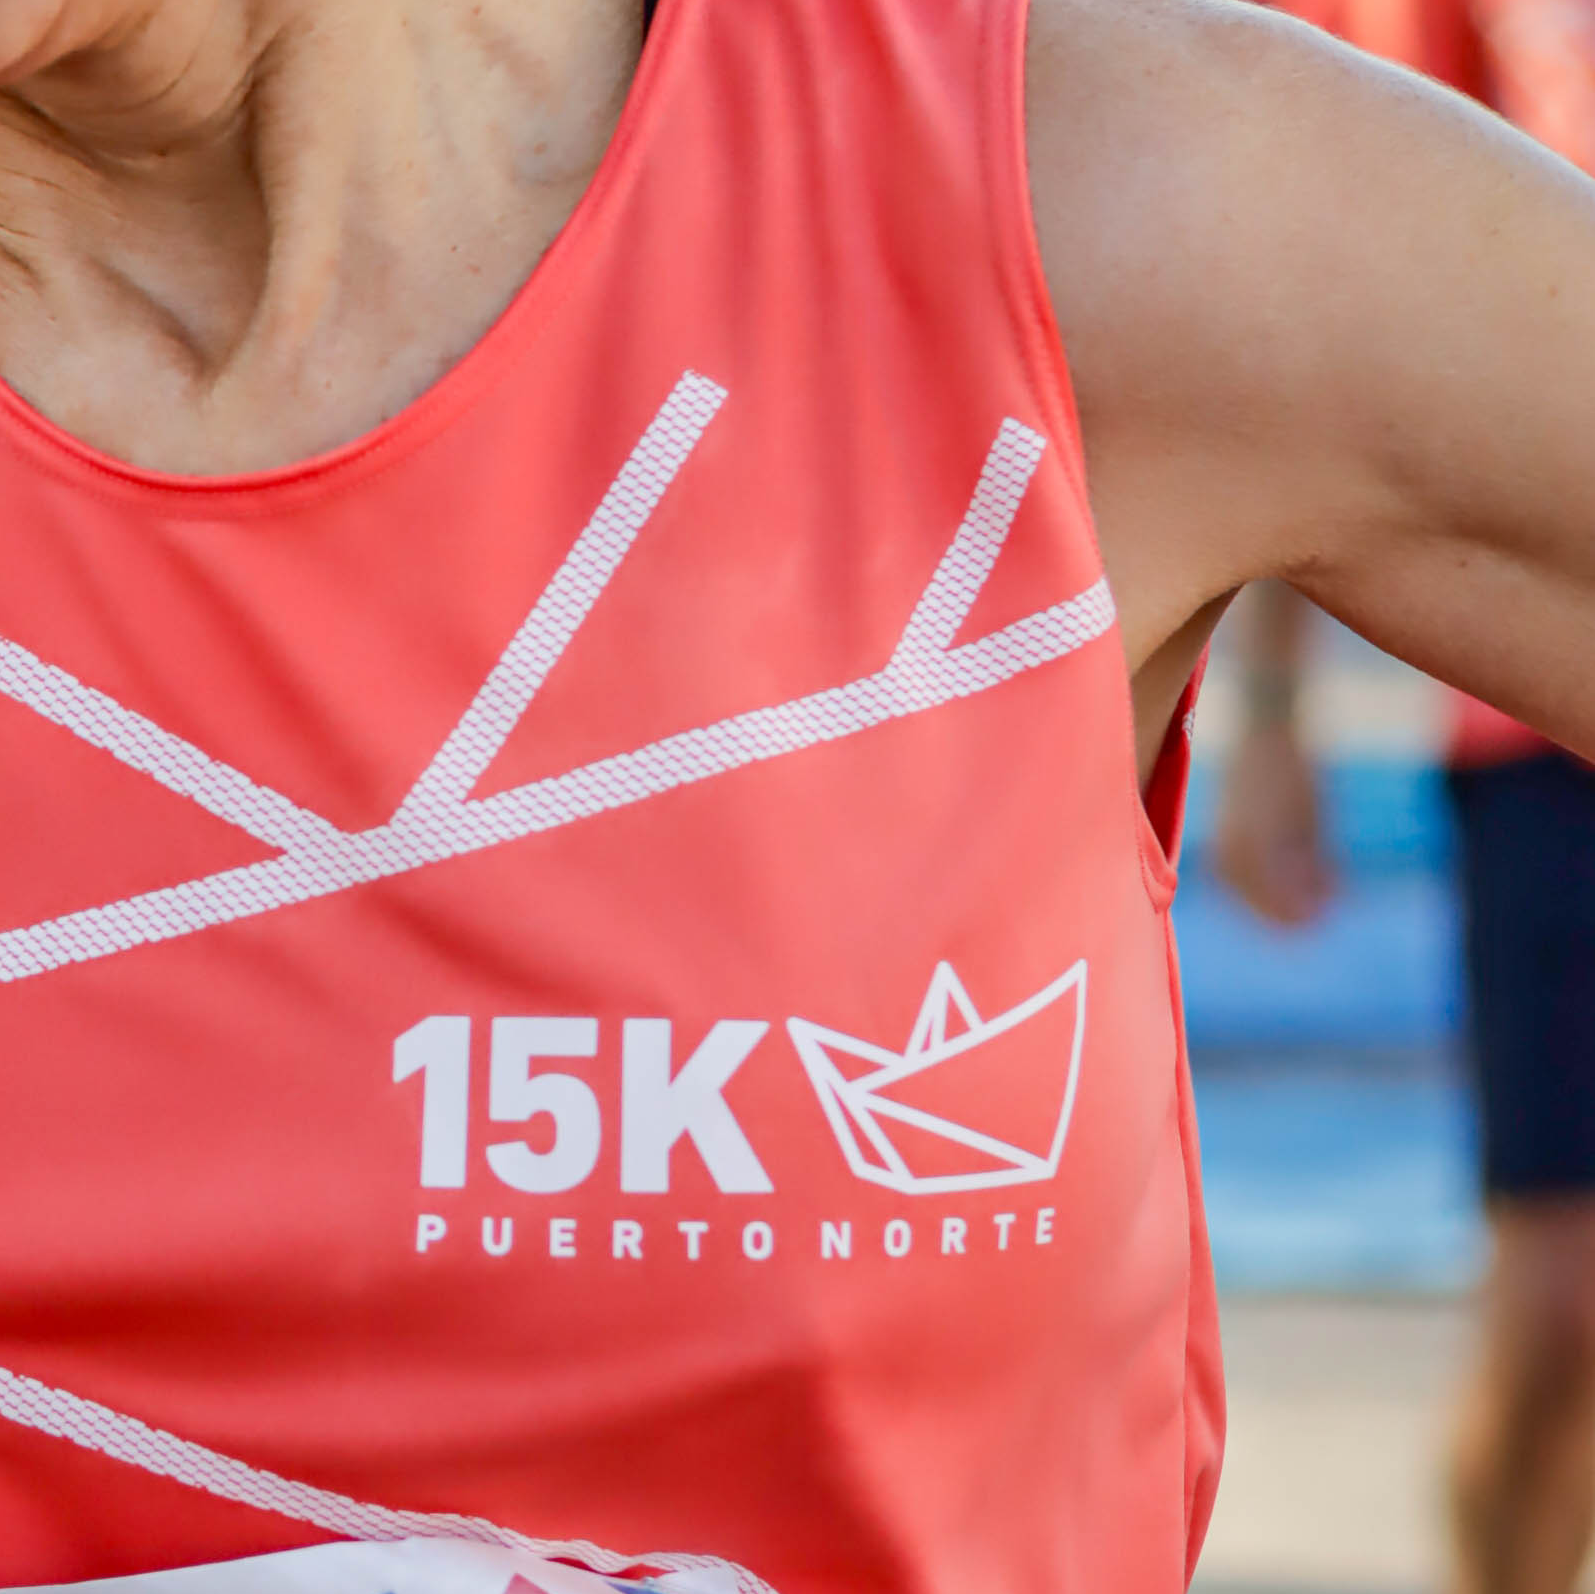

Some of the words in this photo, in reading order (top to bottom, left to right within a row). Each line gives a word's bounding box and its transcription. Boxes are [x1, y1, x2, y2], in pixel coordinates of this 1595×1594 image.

[393, 1015, 774, 1194] 15K
[416, 1214, 773, 1260] PUERTO
[821, 1208, 1055, 1260] NORTE
